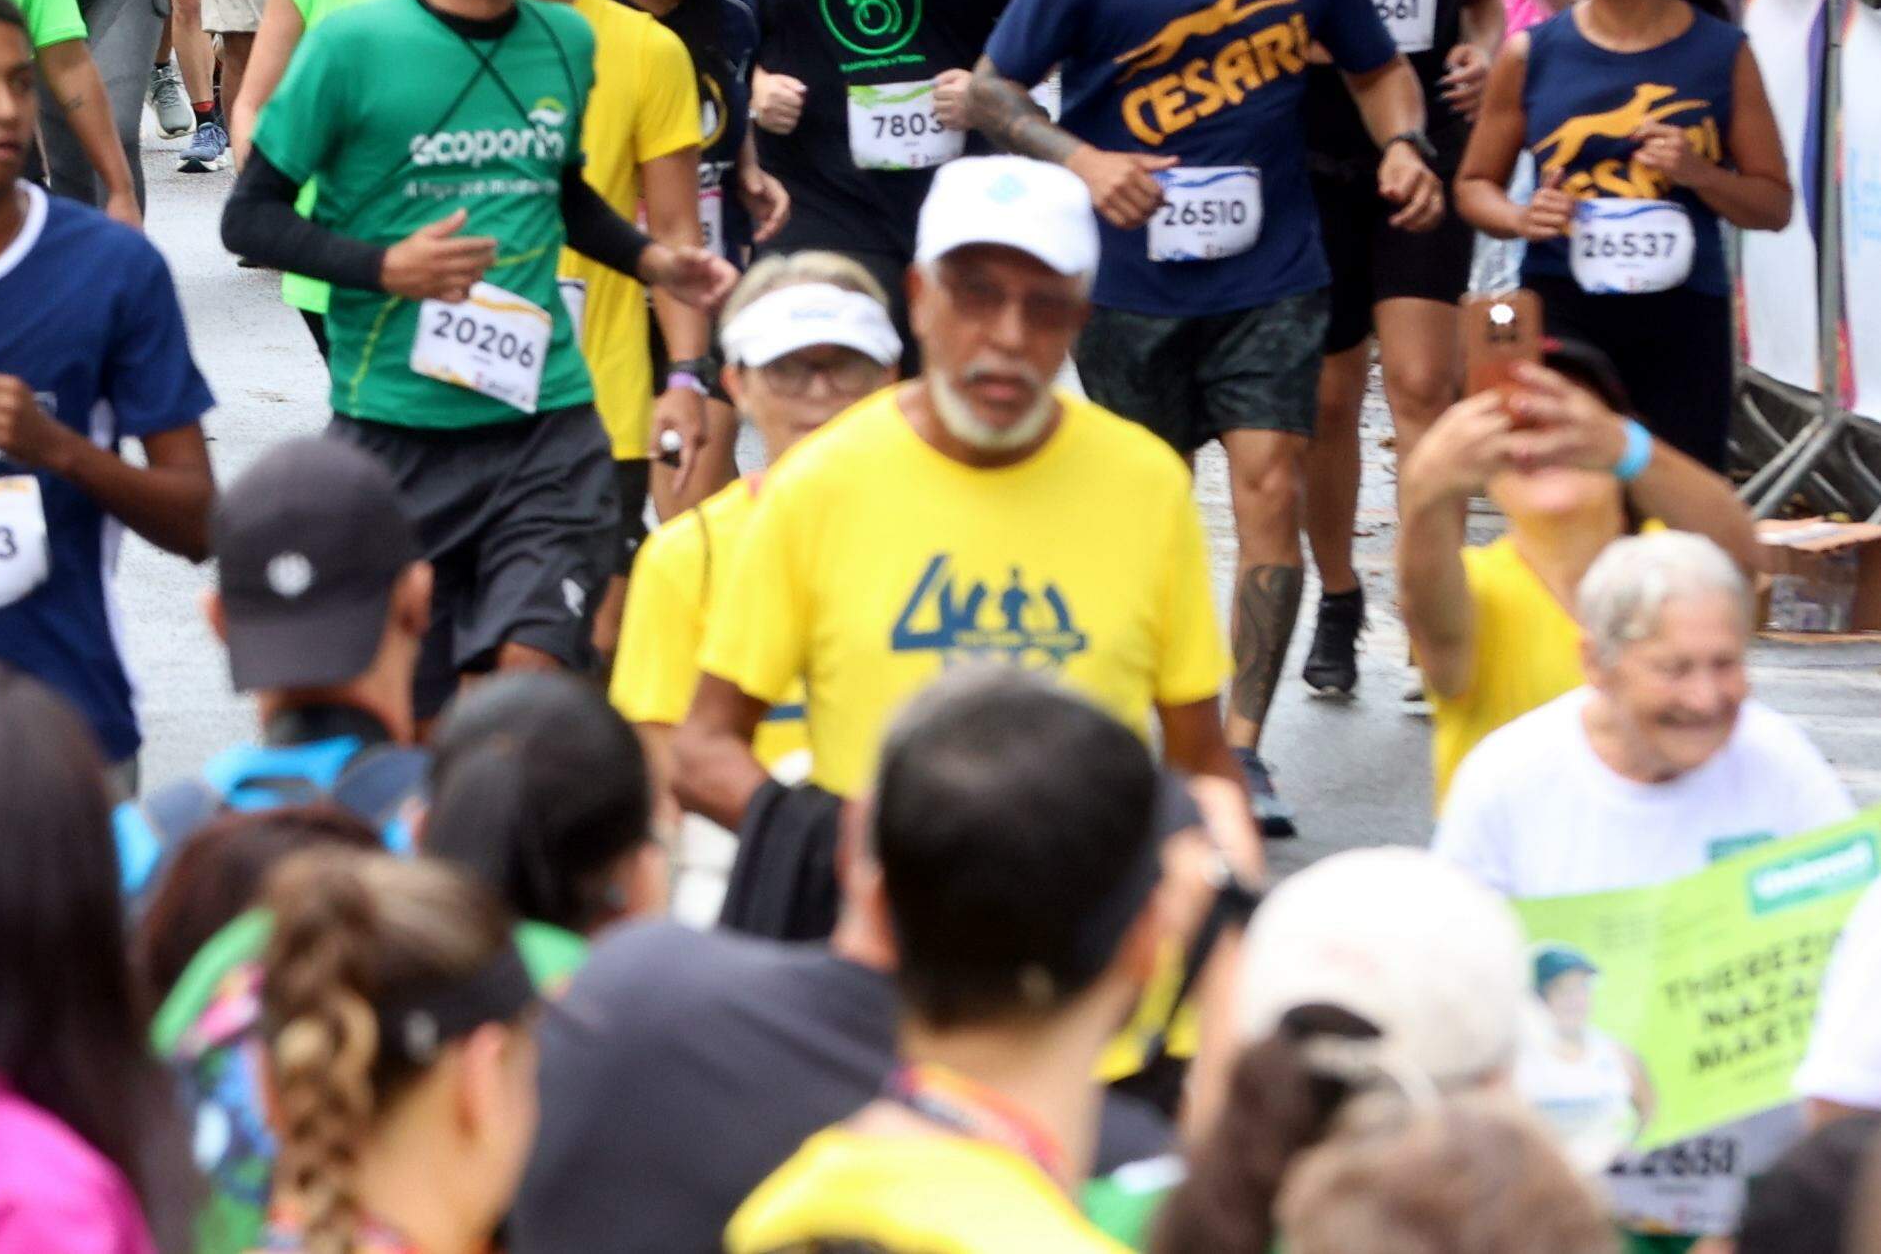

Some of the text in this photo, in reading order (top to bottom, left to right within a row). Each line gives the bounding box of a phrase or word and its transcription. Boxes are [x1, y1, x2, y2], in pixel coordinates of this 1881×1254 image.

[1164, 200, 1247, 227] 26510
[1581, 232, 1677, 259] 26537
[433, 310, 535, 369] 20206
